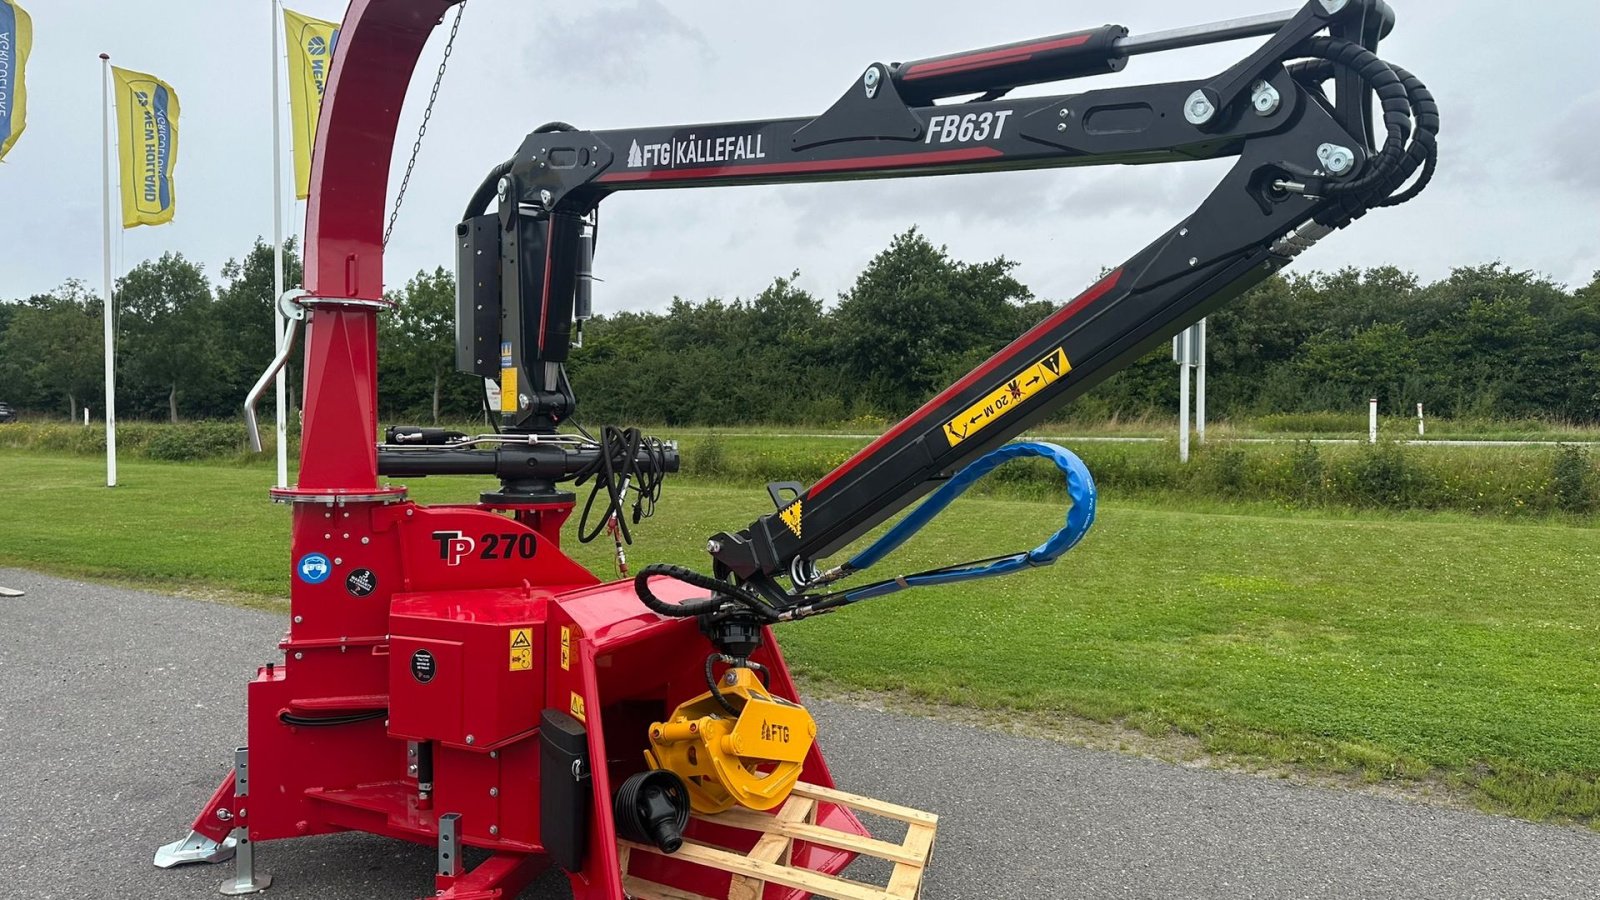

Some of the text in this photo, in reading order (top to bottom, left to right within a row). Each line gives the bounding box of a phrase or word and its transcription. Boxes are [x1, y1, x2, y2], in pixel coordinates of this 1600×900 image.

[925, 110, 1013, 144] FB63T
[643, 134, 766, 167] FTG KÄLLEFALL
[983, 395, 1009, 418] 20 M
[432, 530, 537, 566] TP 270
[771, 723, 790, 744] FTG
